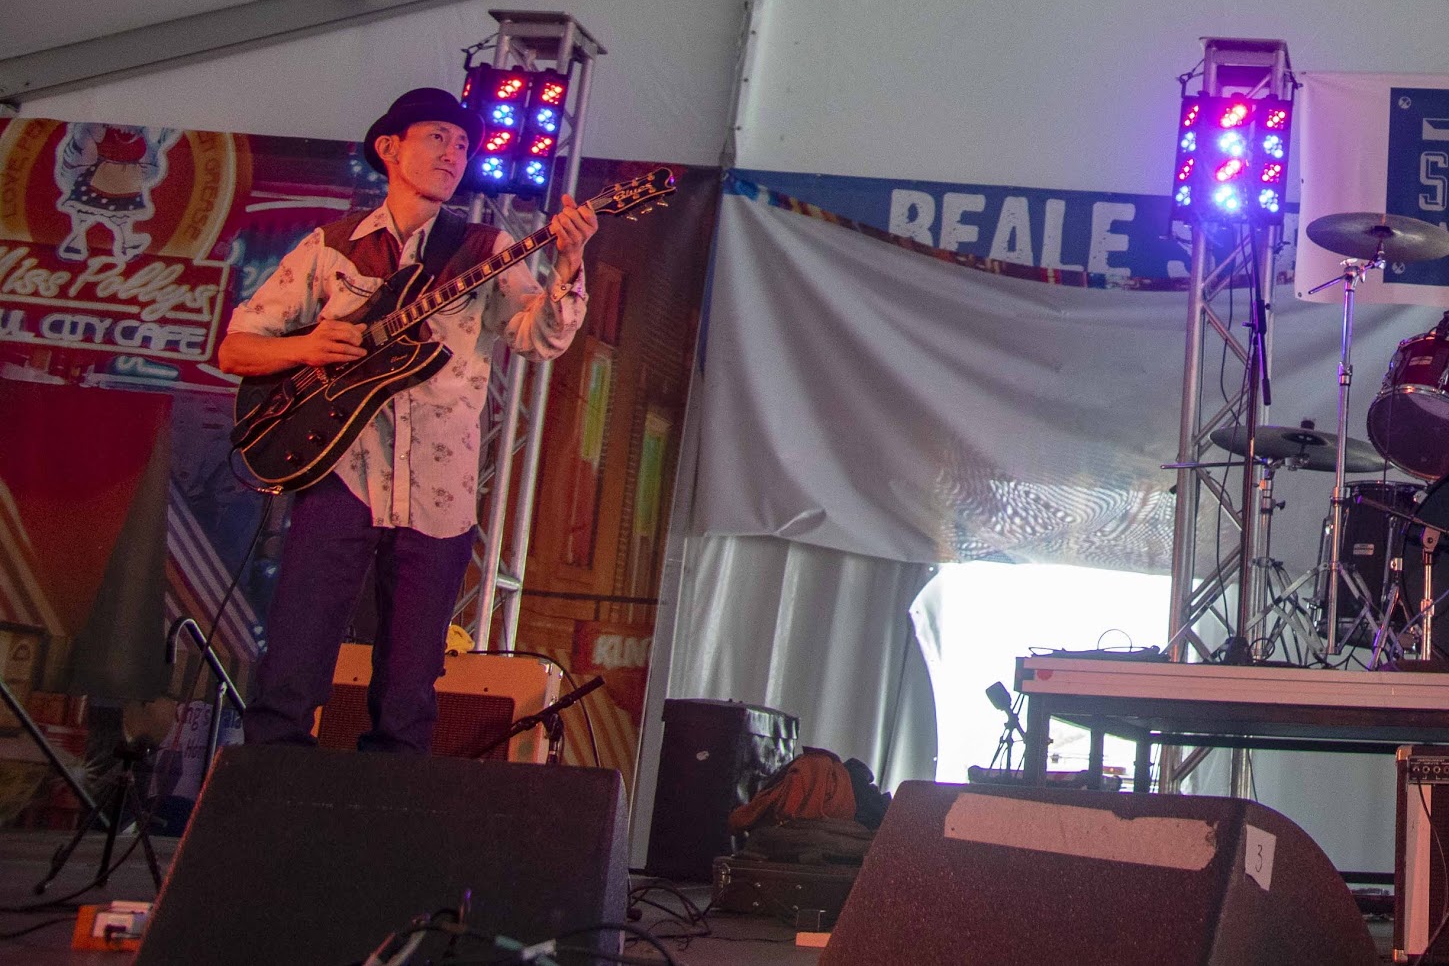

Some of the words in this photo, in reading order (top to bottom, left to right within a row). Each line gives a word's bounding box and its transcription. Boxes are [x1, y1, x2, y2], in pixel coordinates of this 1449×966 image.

[889, 188, 1137, 278] BEALE
[113, 319, 207, 354] CAFE
[1255, 844, 1263, 873] 3
